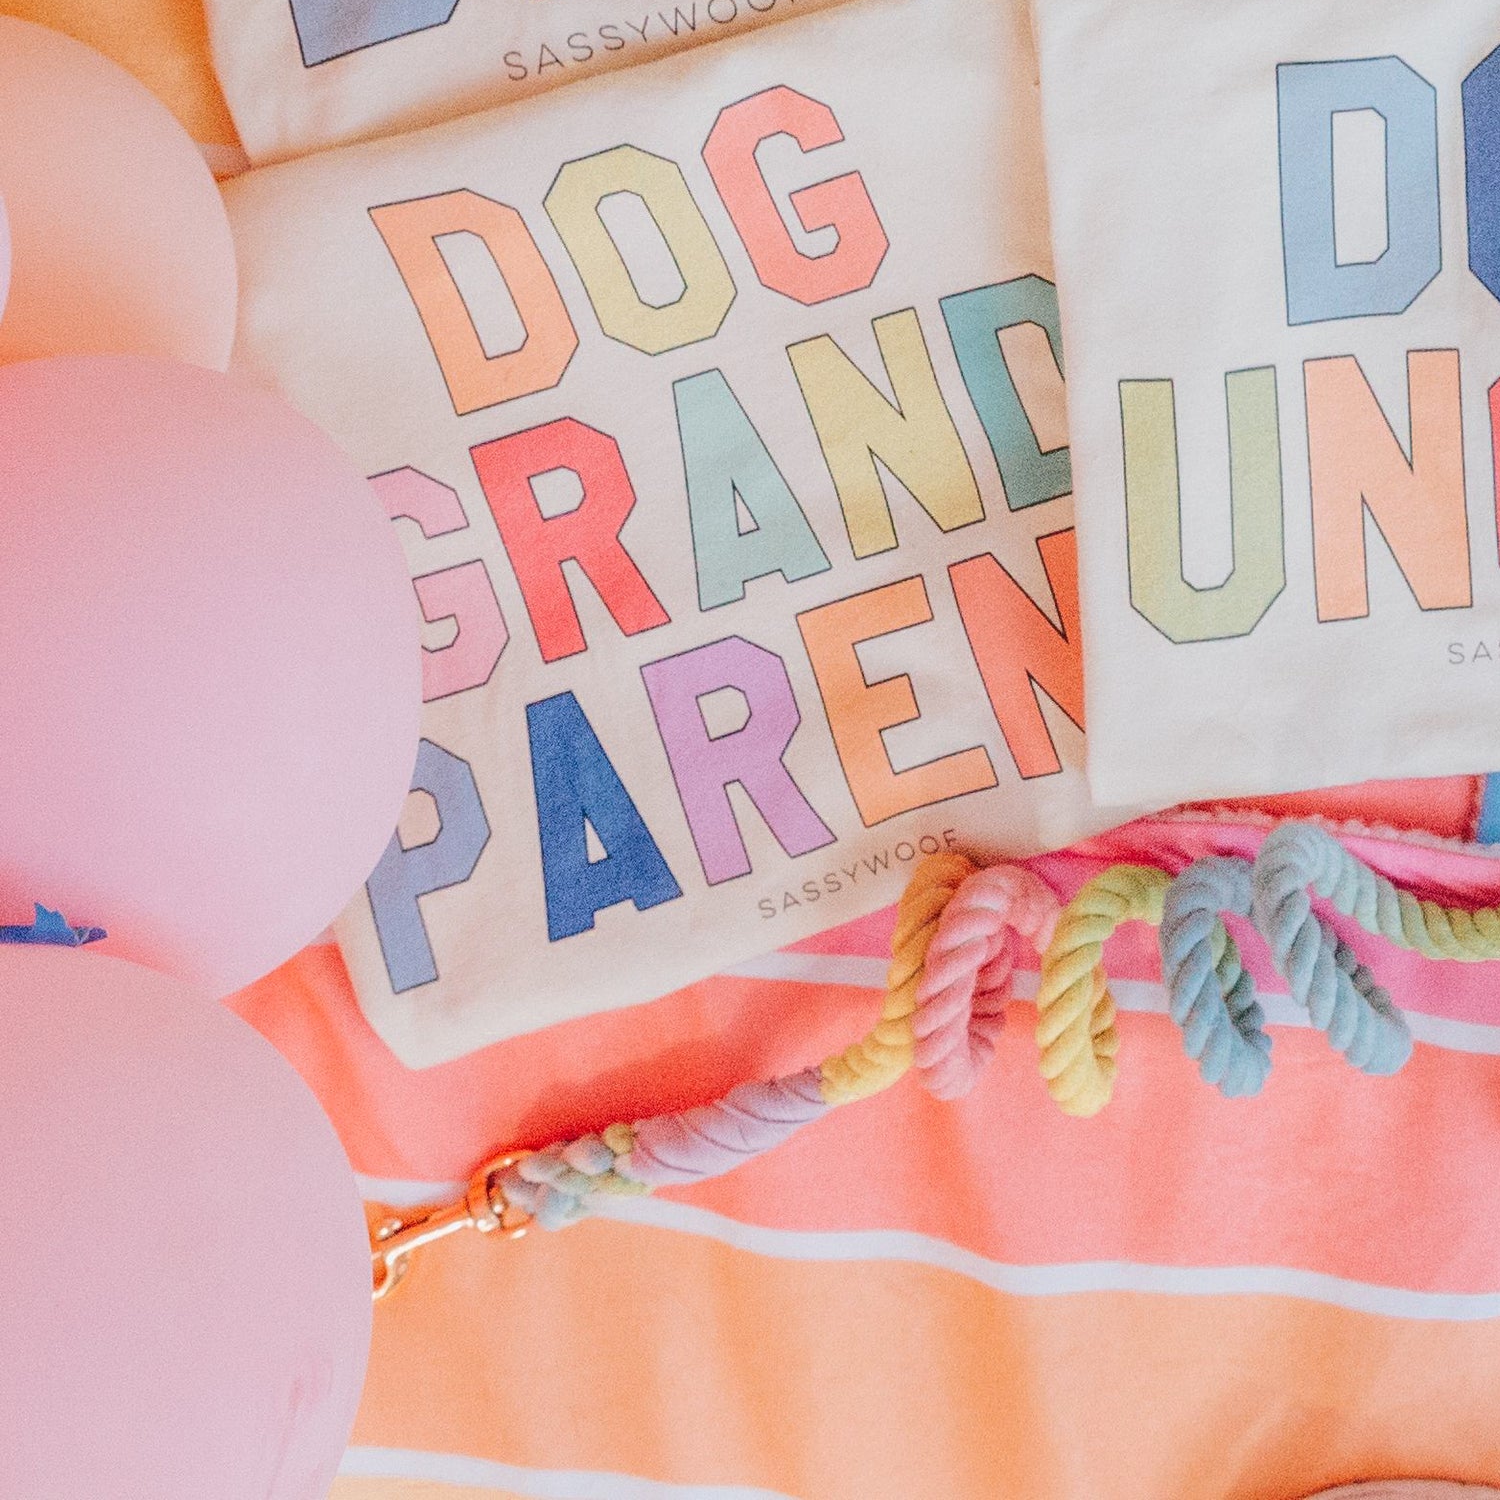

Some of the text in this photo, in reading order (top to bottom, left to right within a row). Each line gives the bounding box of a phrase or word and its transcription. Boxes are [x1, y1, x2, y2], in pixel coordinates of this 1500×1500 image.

[368, 84, 890, 417] DOG
[366, 273, 1074, 703] GRAND
[757, 828, 958, 920] SASSYWOOF
